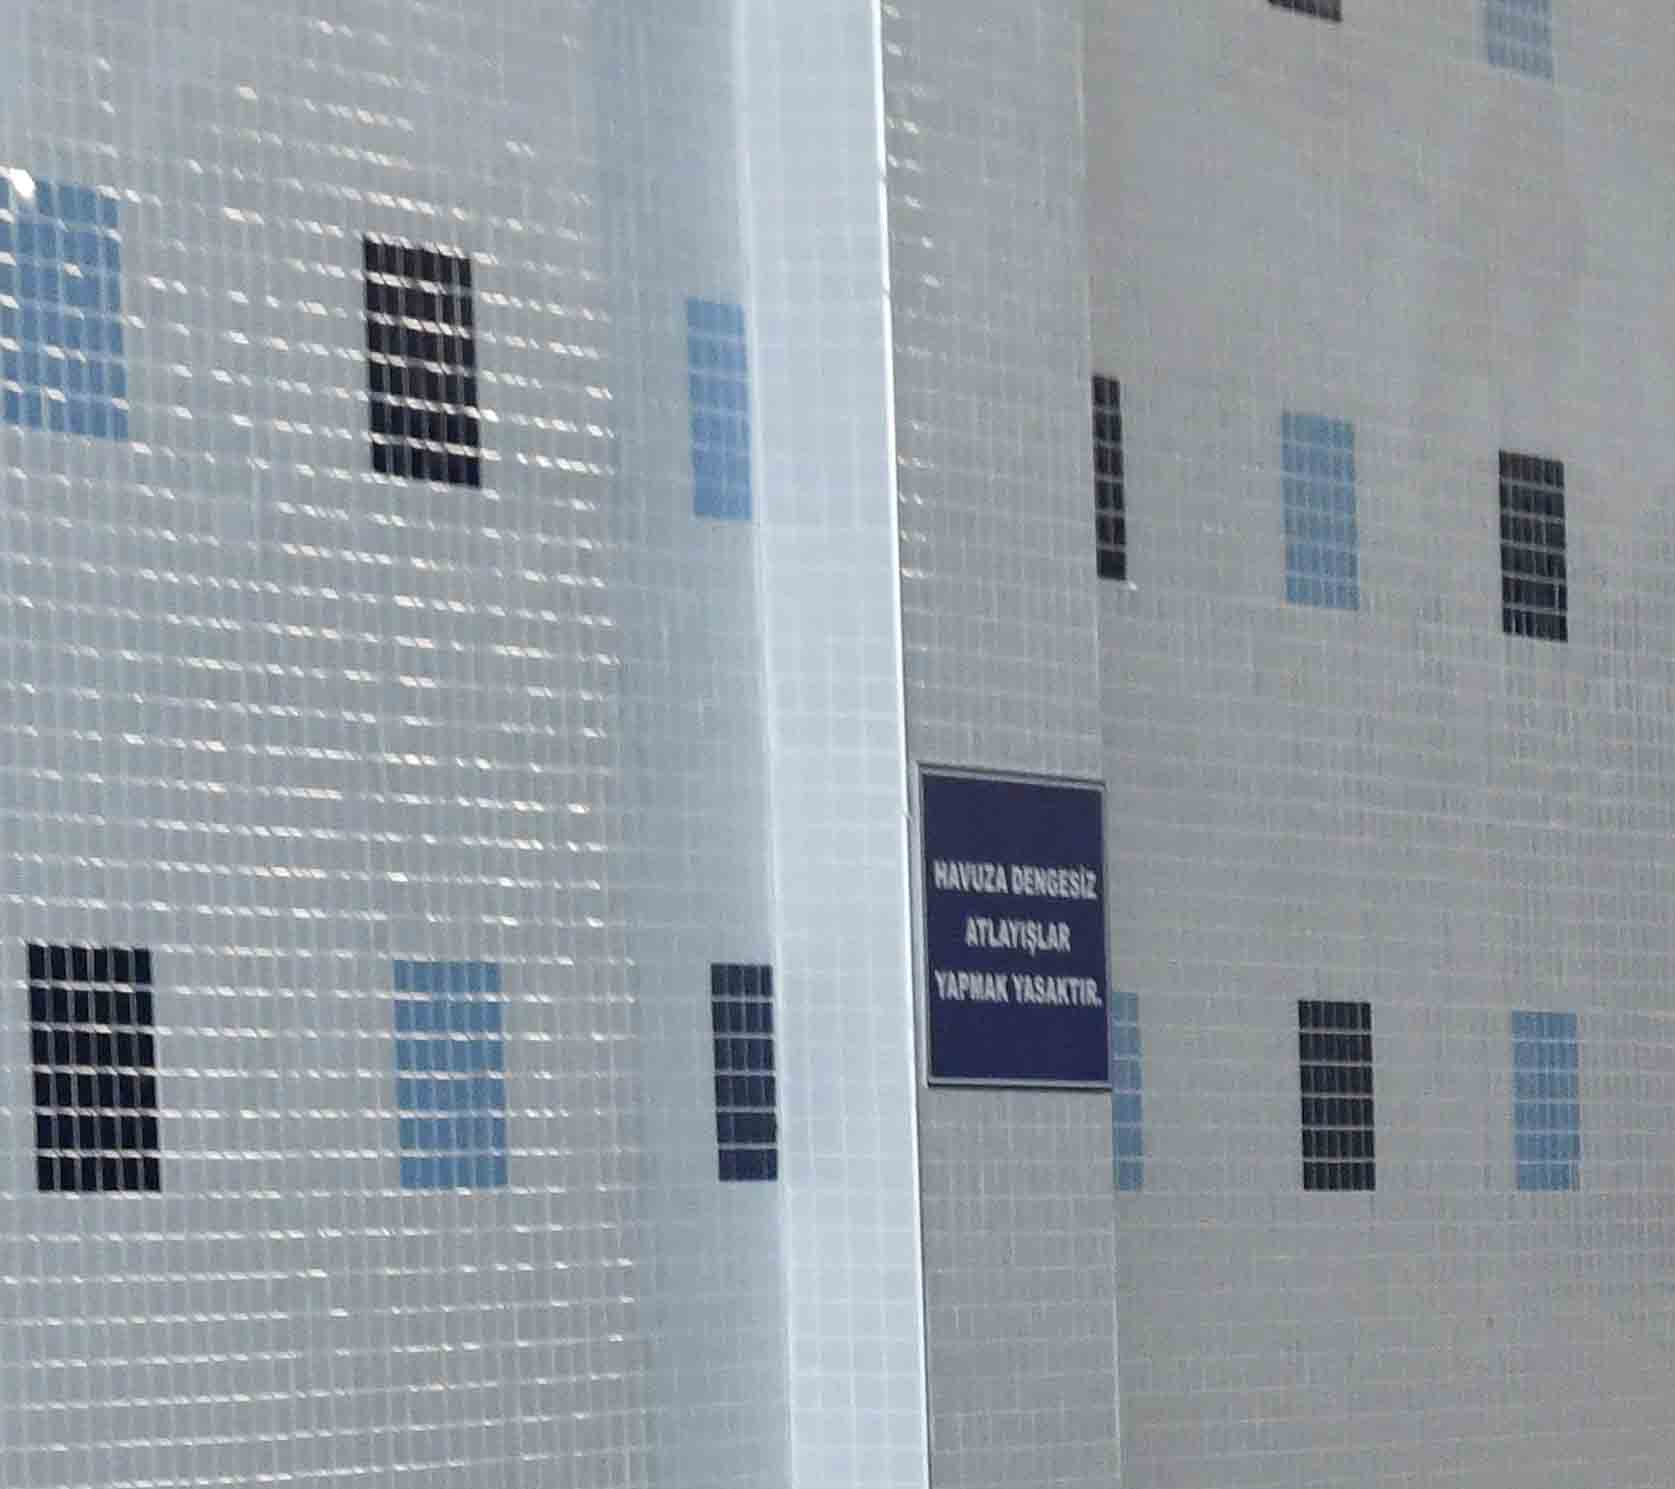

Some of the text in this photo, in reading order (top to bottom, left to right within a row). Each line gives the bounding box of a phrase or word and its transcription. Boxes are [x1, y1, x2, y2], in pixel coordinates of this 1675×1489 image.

[933, 859, 1097, 900] HAVUZA DENGESİZ
[965, 917, 1071, 957] ATLAYIŞLAR
[934, 969, 1103, 1007] YAPMAK YASAKTIR.
